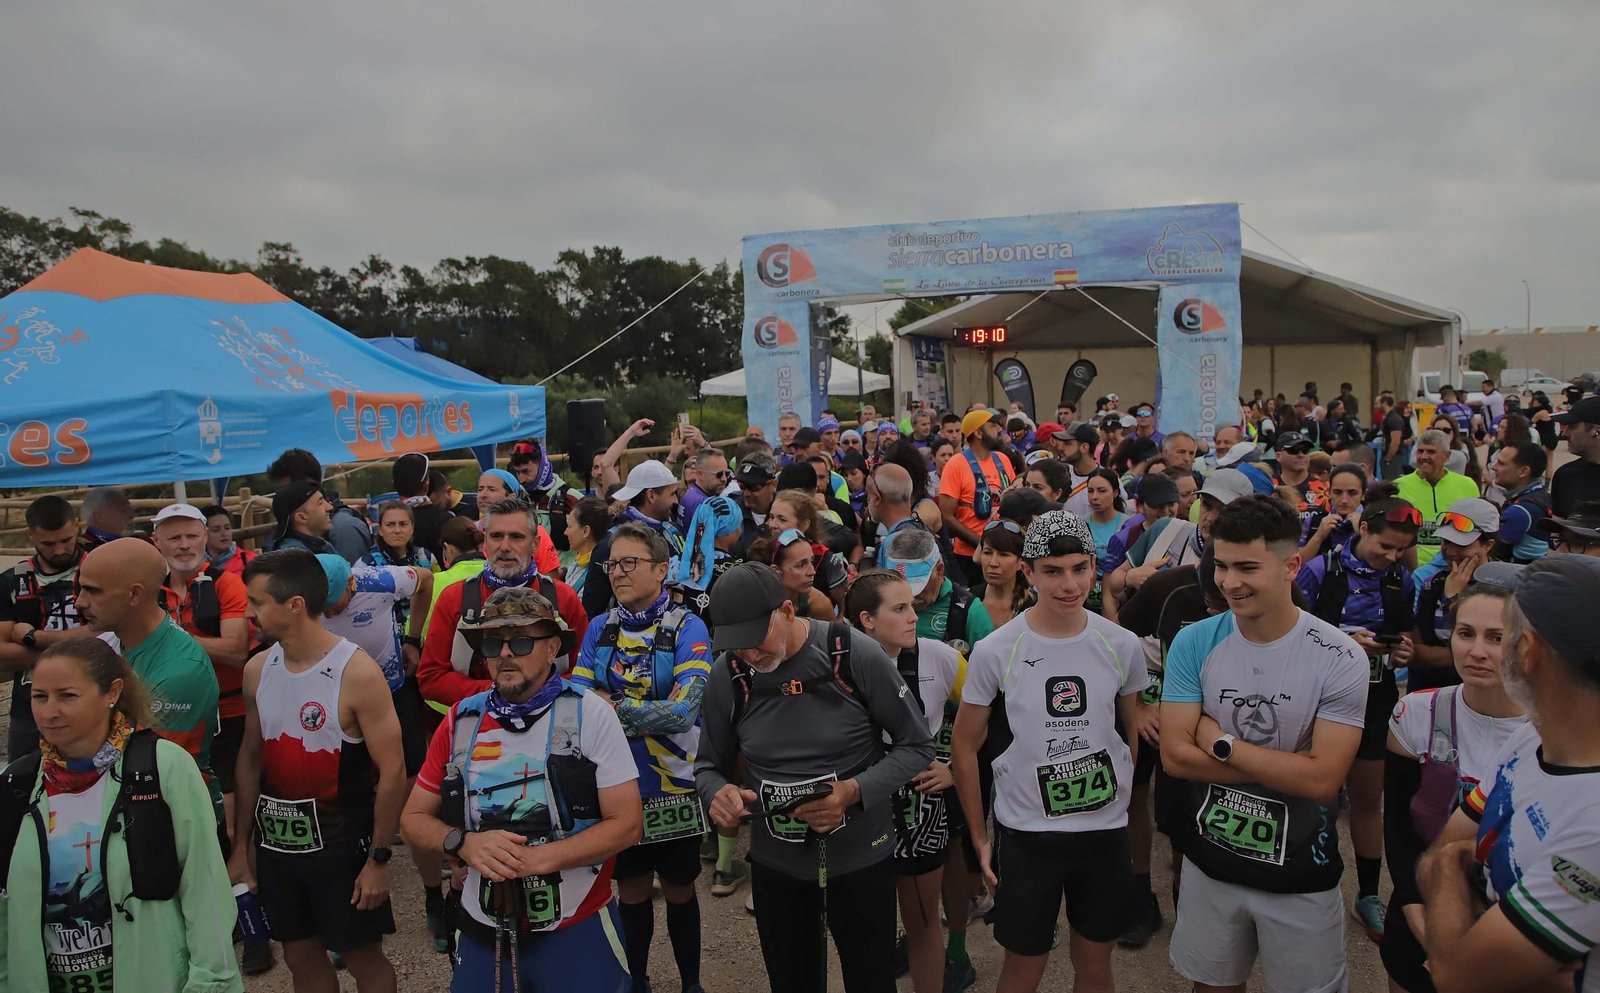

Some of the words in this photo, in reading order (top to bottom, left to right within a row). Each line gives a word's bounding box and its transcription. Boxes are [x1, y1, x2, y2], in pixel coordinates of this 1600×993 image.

[888, 233, 916, 247] club
[918, 230, 980, 247] deportivo
[888, 241, 1074, 269] sierracarbonera
[335, 391, 474, 452] deportes
[0, 418, 92, 467] es
[1045, 719, 1090, 728] asodena
[1049, 761, 1102, 780] CARBONERA
[1053, 762, 1074, 774] XIII
[774, 786, 791, 796] XIII
[1052, 770, 1108, 802] 374
[132, 793, 158, 801] KIPRUN
[644, 796, 691, 810] CARBONERA
[1224, 790, 1242, 804] XIII
[266, 800, 277, 810] XIII
[1217, 798, 1273, 819] CARBONERA
[1241, 800, 1267, 811] CRESTA
[262, 808, 304, 817] CARBONERA
[646, 804, 694, 828] 230
[265, 816, 308, 837] 376
[1210, 809, 1273, 842] 270
[872, 833, 889, 847] RACE
[71, 953, 105, 965] CRESTA
